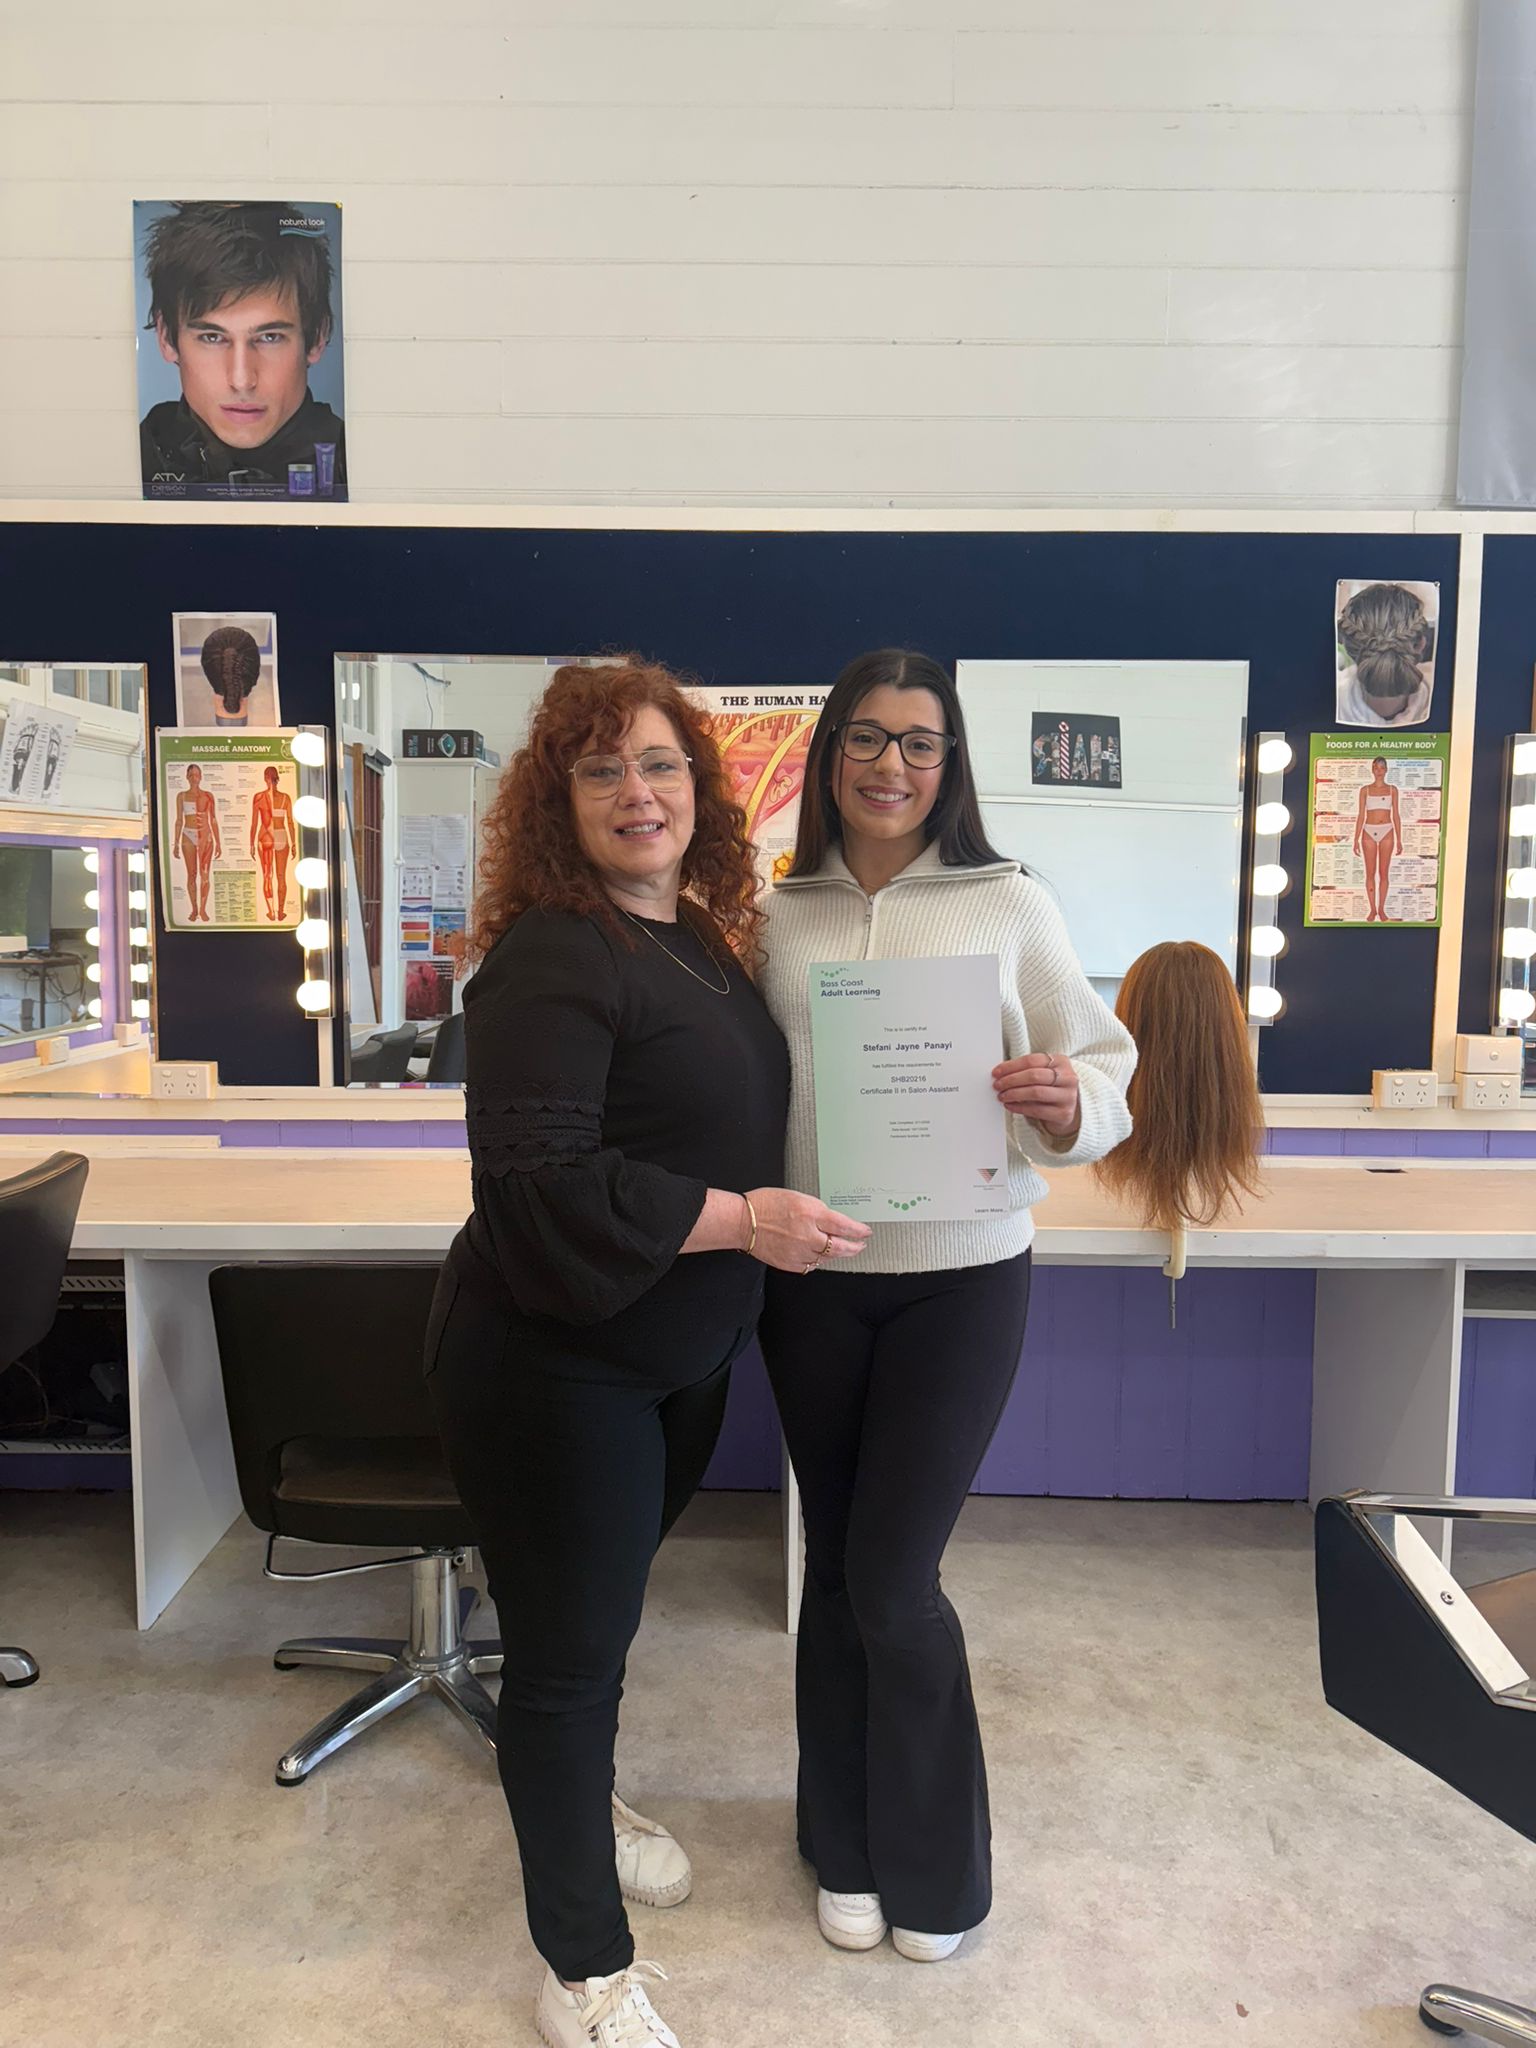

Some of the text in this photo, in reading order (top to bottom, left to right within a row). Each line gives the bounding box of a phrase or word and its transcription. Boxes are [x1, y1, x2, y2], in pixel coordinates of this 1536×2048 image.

[279, 218, 326, 226] natural look
[151, 472, 185, 481] ATV
[720, 696, 749, 706] THE
[754, 696, 804, 706] HUMAN
[820, 979, 864, 988] Bass Coast
[845, 988, 881, 997] Learning
[863, 1041, 953, 1052] Stefani Jayne Panayi
[891, 1075, 927, 1083] SHB20216
[860, 1087, 893, 1095] Certificate
[908, 1086, 928, 1094] Salon
[929, 1085, 960, 1093] Assistant
